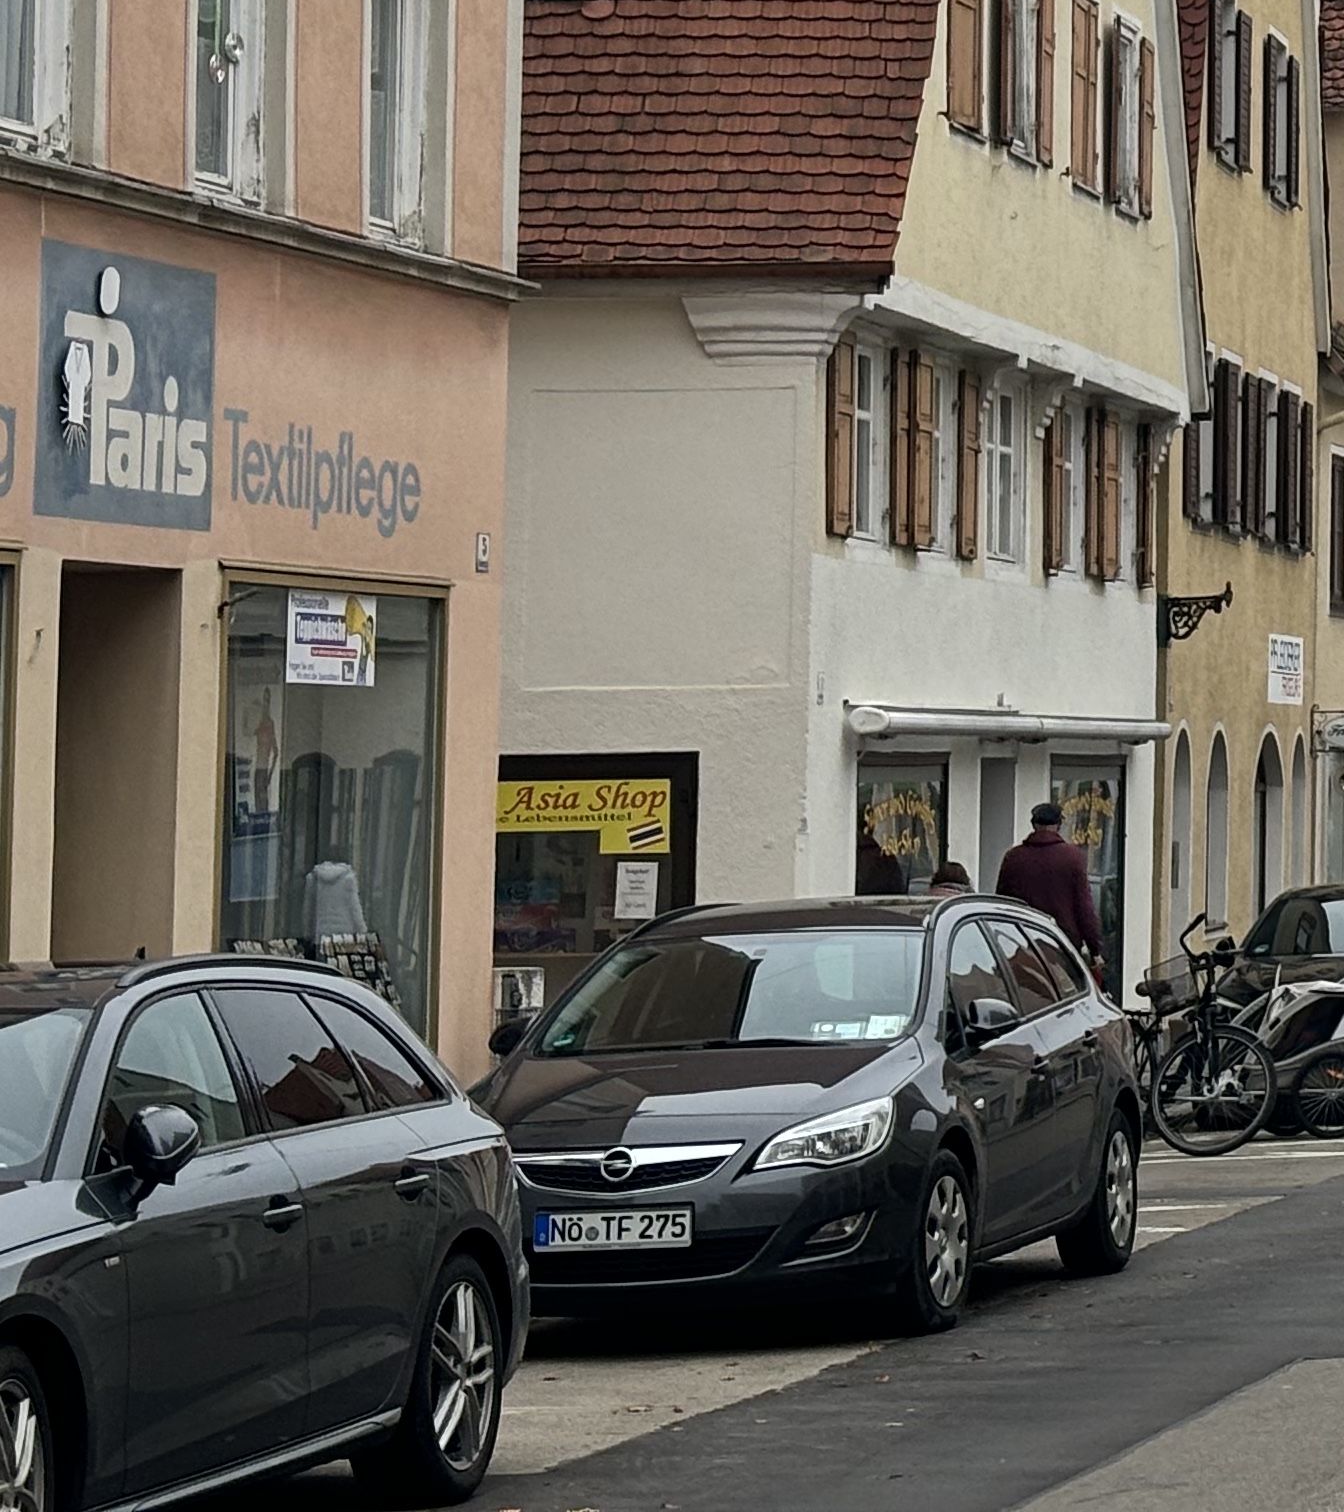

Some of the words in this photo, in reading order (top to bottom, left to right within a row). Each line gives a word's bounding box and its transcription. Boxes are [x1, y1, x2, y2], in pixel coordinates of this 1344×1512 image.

[64, 310, 207, 497] Paris
[223, 408, 421, 538] Textilpflege
[504, 784, 580, 815] Asia
[588, 782, 667, 818] Shop
[516, 812, 632, 823] Lebensmittel
[550, 1217, 584, 1243] NÖ
[601, 1215, 634, 1241] TF
[639, 1213, 687, 1239] 275
